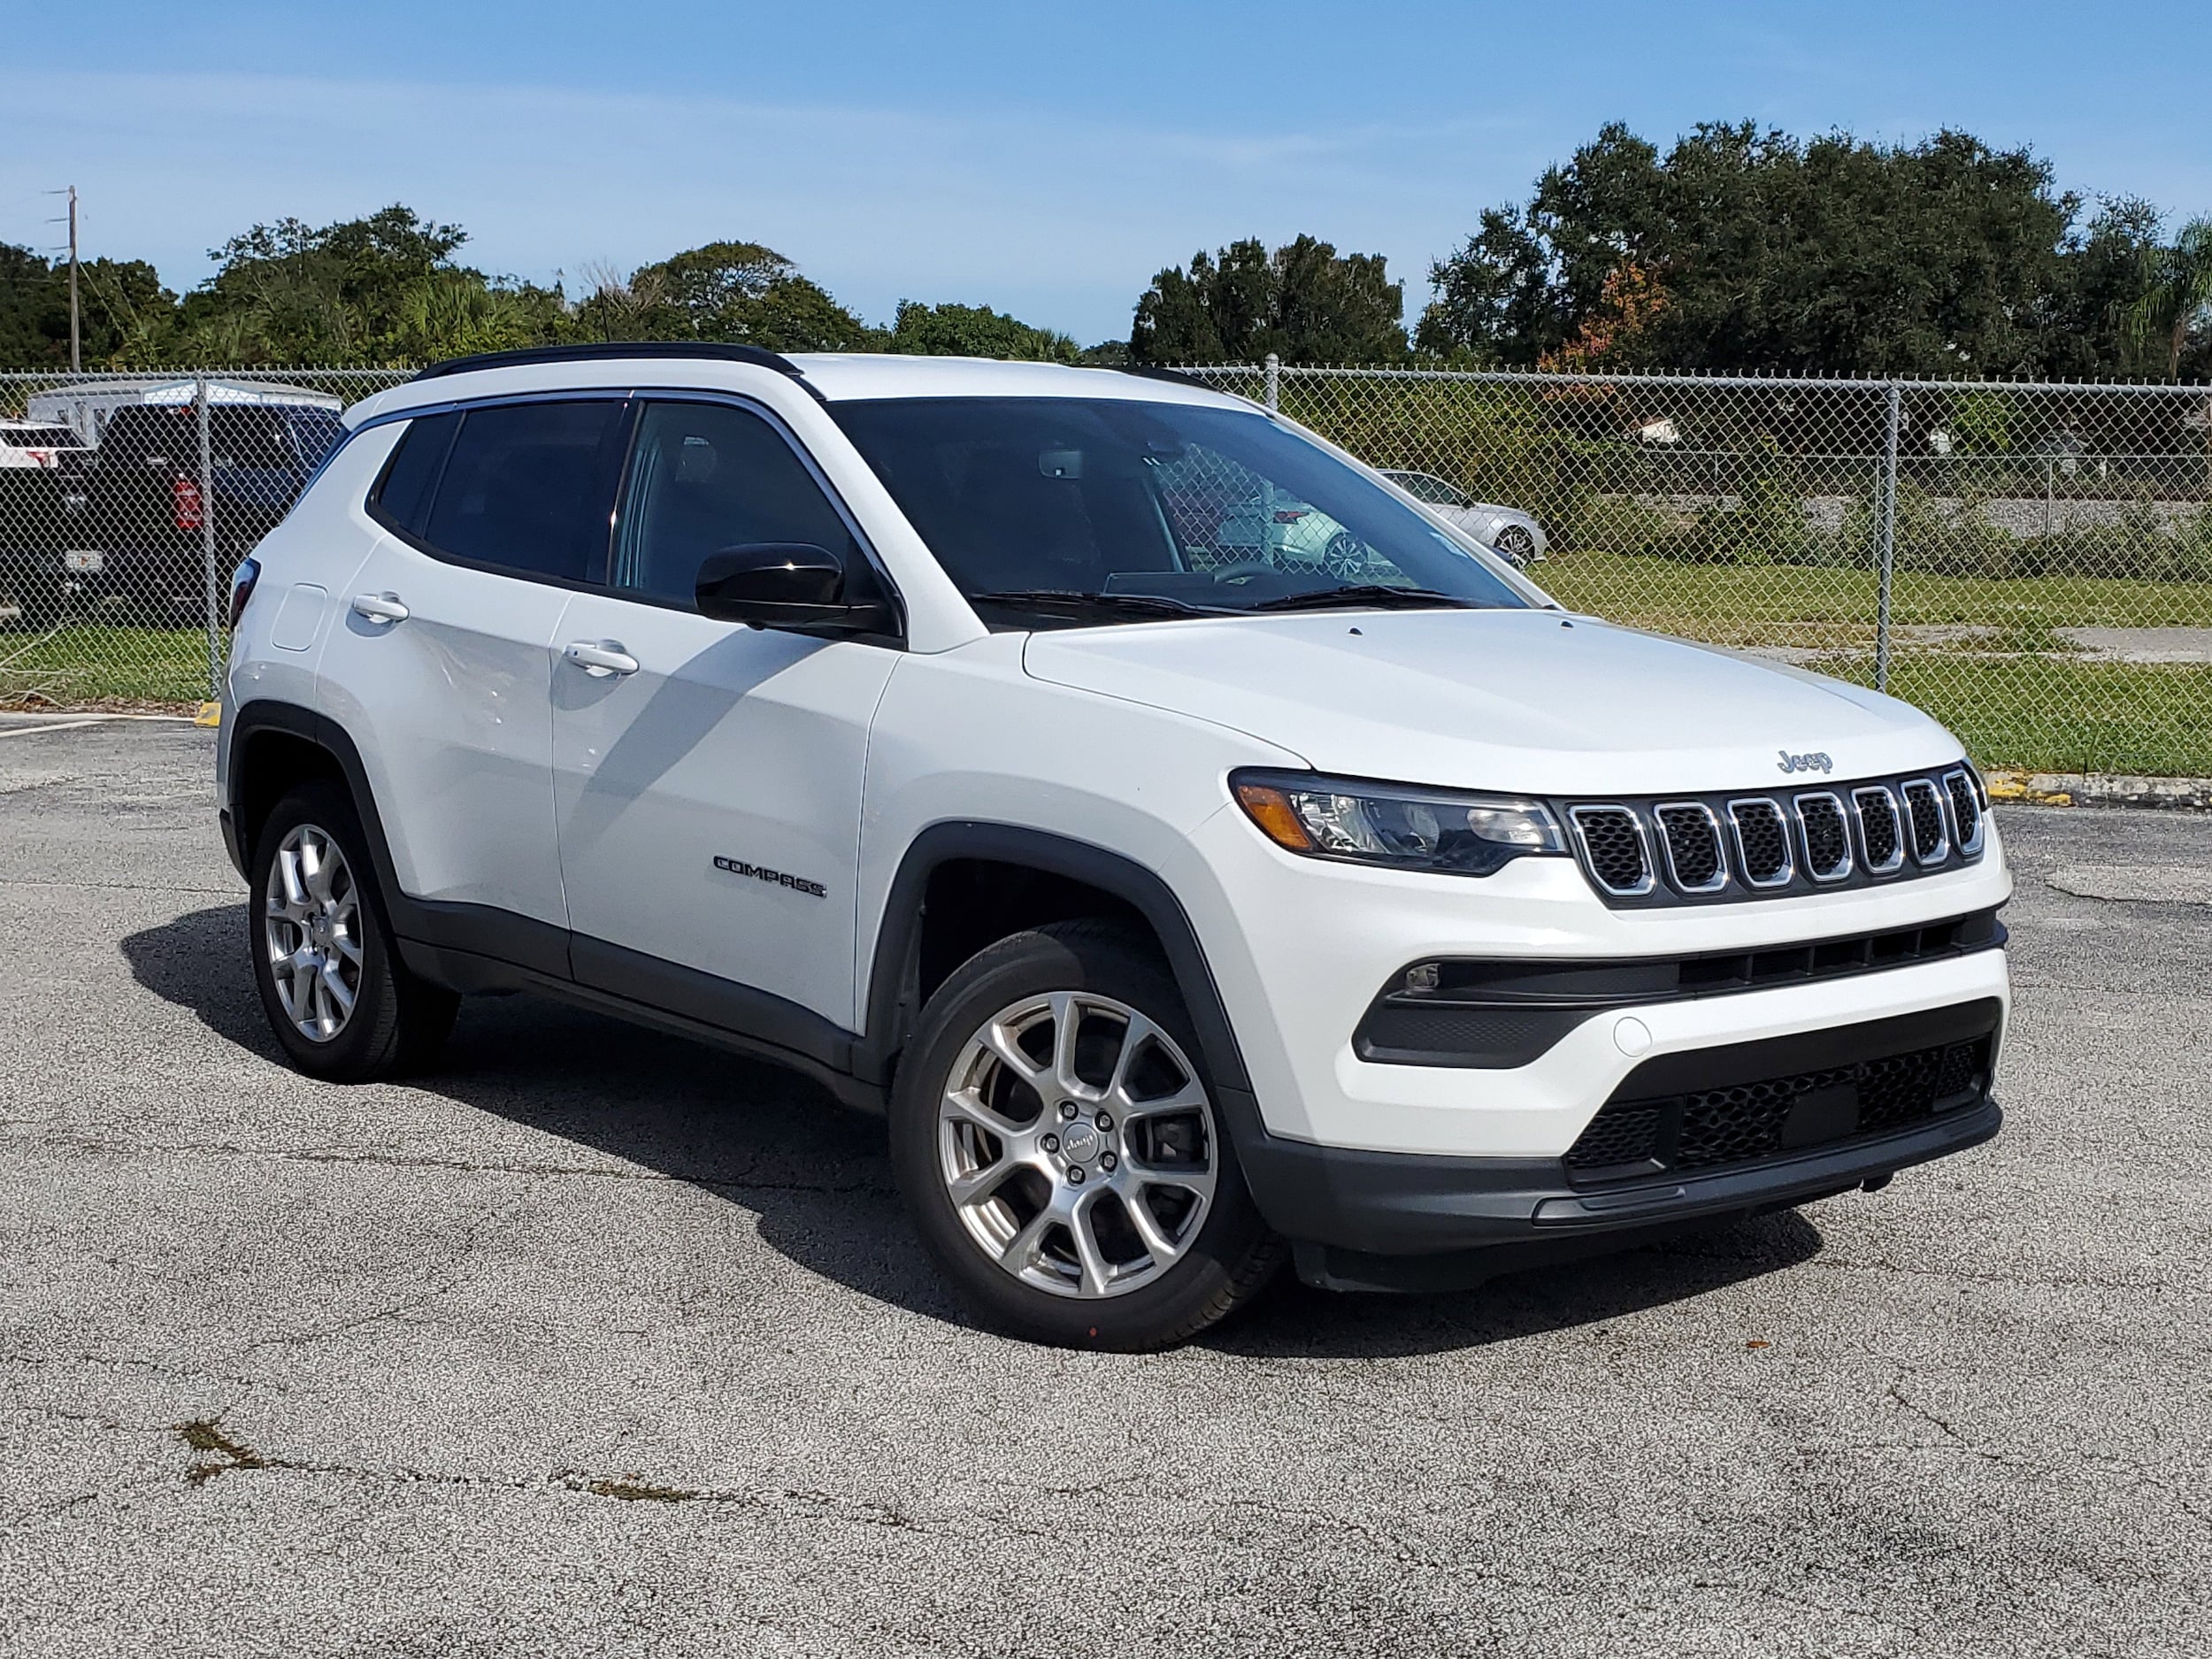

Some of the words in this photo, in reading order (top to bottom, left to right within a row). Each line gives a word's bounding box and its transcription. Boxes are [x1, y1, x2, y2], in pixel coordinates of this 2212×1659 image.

[1777, 750, 1833, 774] Jeep
[713, 855, 827, 898] COMPASS
[1065, 1133, 1094, 1150] Jeep
